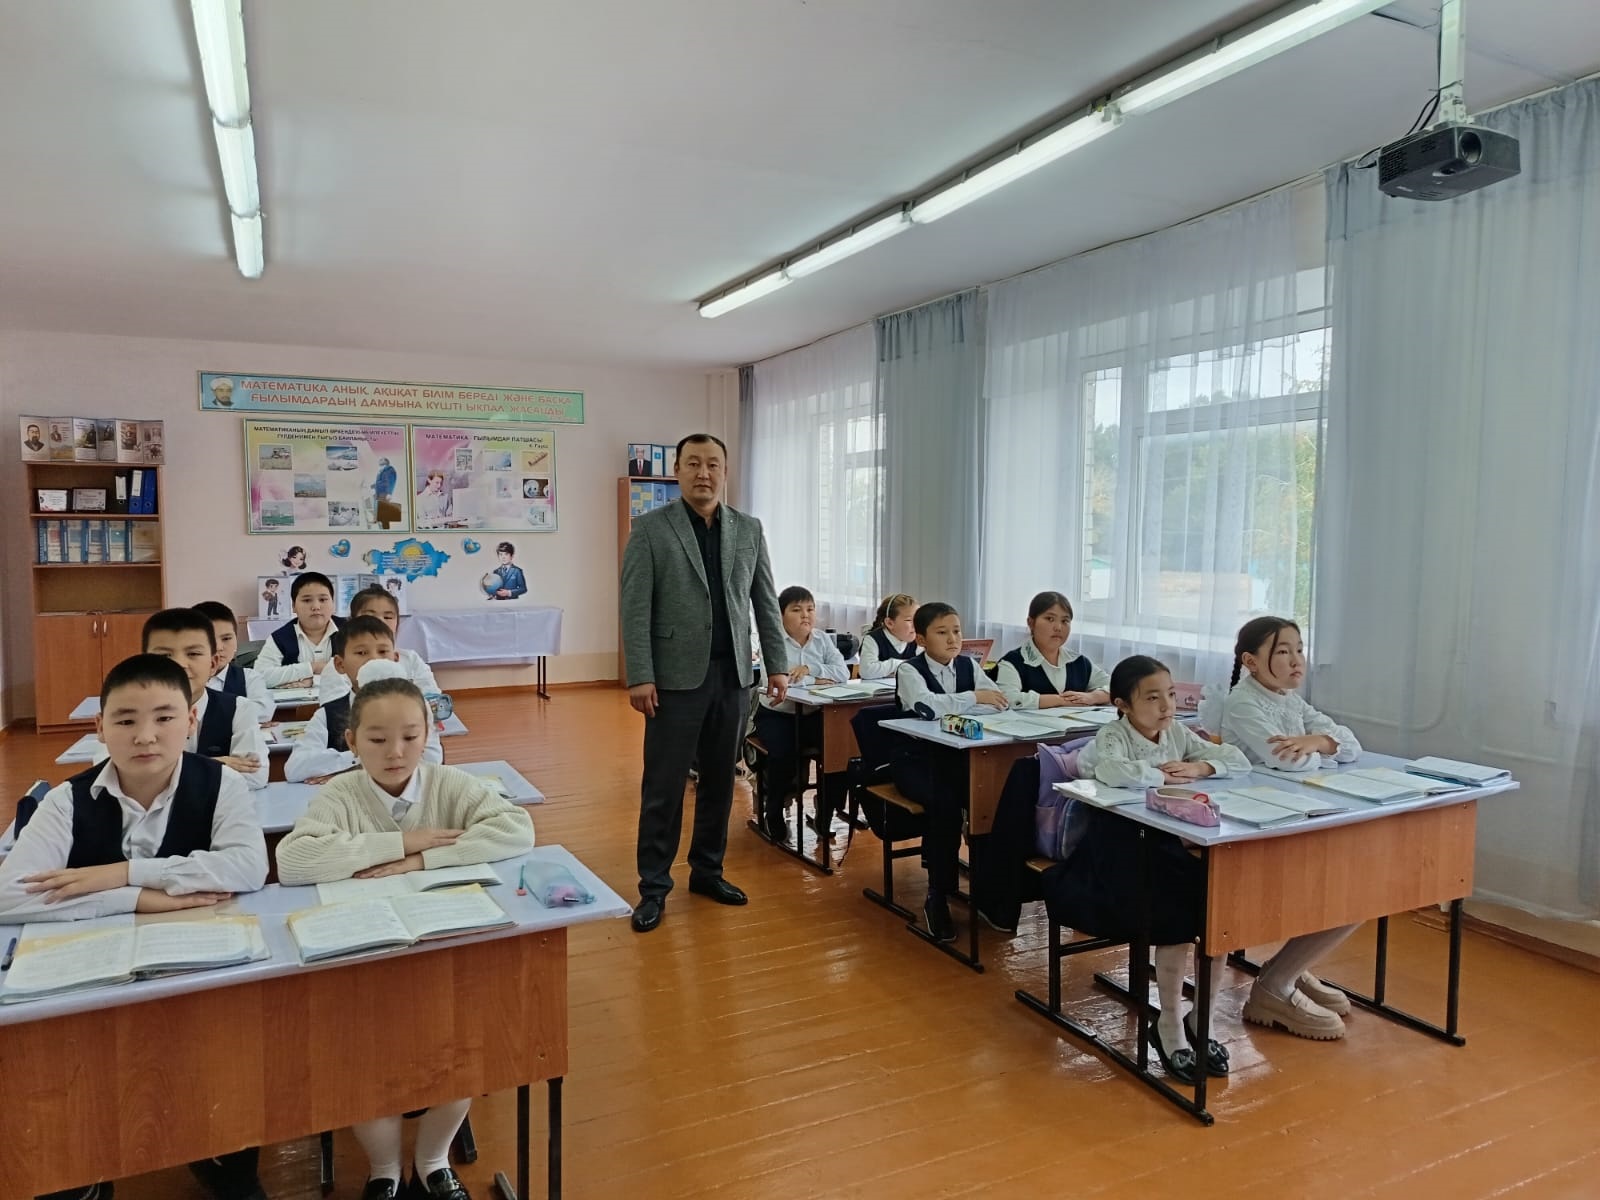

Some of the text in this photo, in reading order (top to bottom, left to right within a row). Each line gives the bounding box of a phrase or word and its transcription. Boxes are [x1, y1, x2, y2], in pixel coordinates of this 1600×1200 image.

[241, 381, 328, 393] МАТЕМАТИКА
[373, 387, 418, 398] АҚИҚАТ
[422, 389, 454, 399] БІЛІМ
[458, 391, 498, 402] БЕРЕДІ
[503, 393, 535, 402] ЖӘНЕ
[251, 393, 356, 407] ҒЫЛЫМДАРДЫҢ
[360, 398, 422, 409] ДАМУЫНА
[426, 401, 462, 411] КҮШТІ
[425, 433, 469, 441] МАТЕМАТИКА
